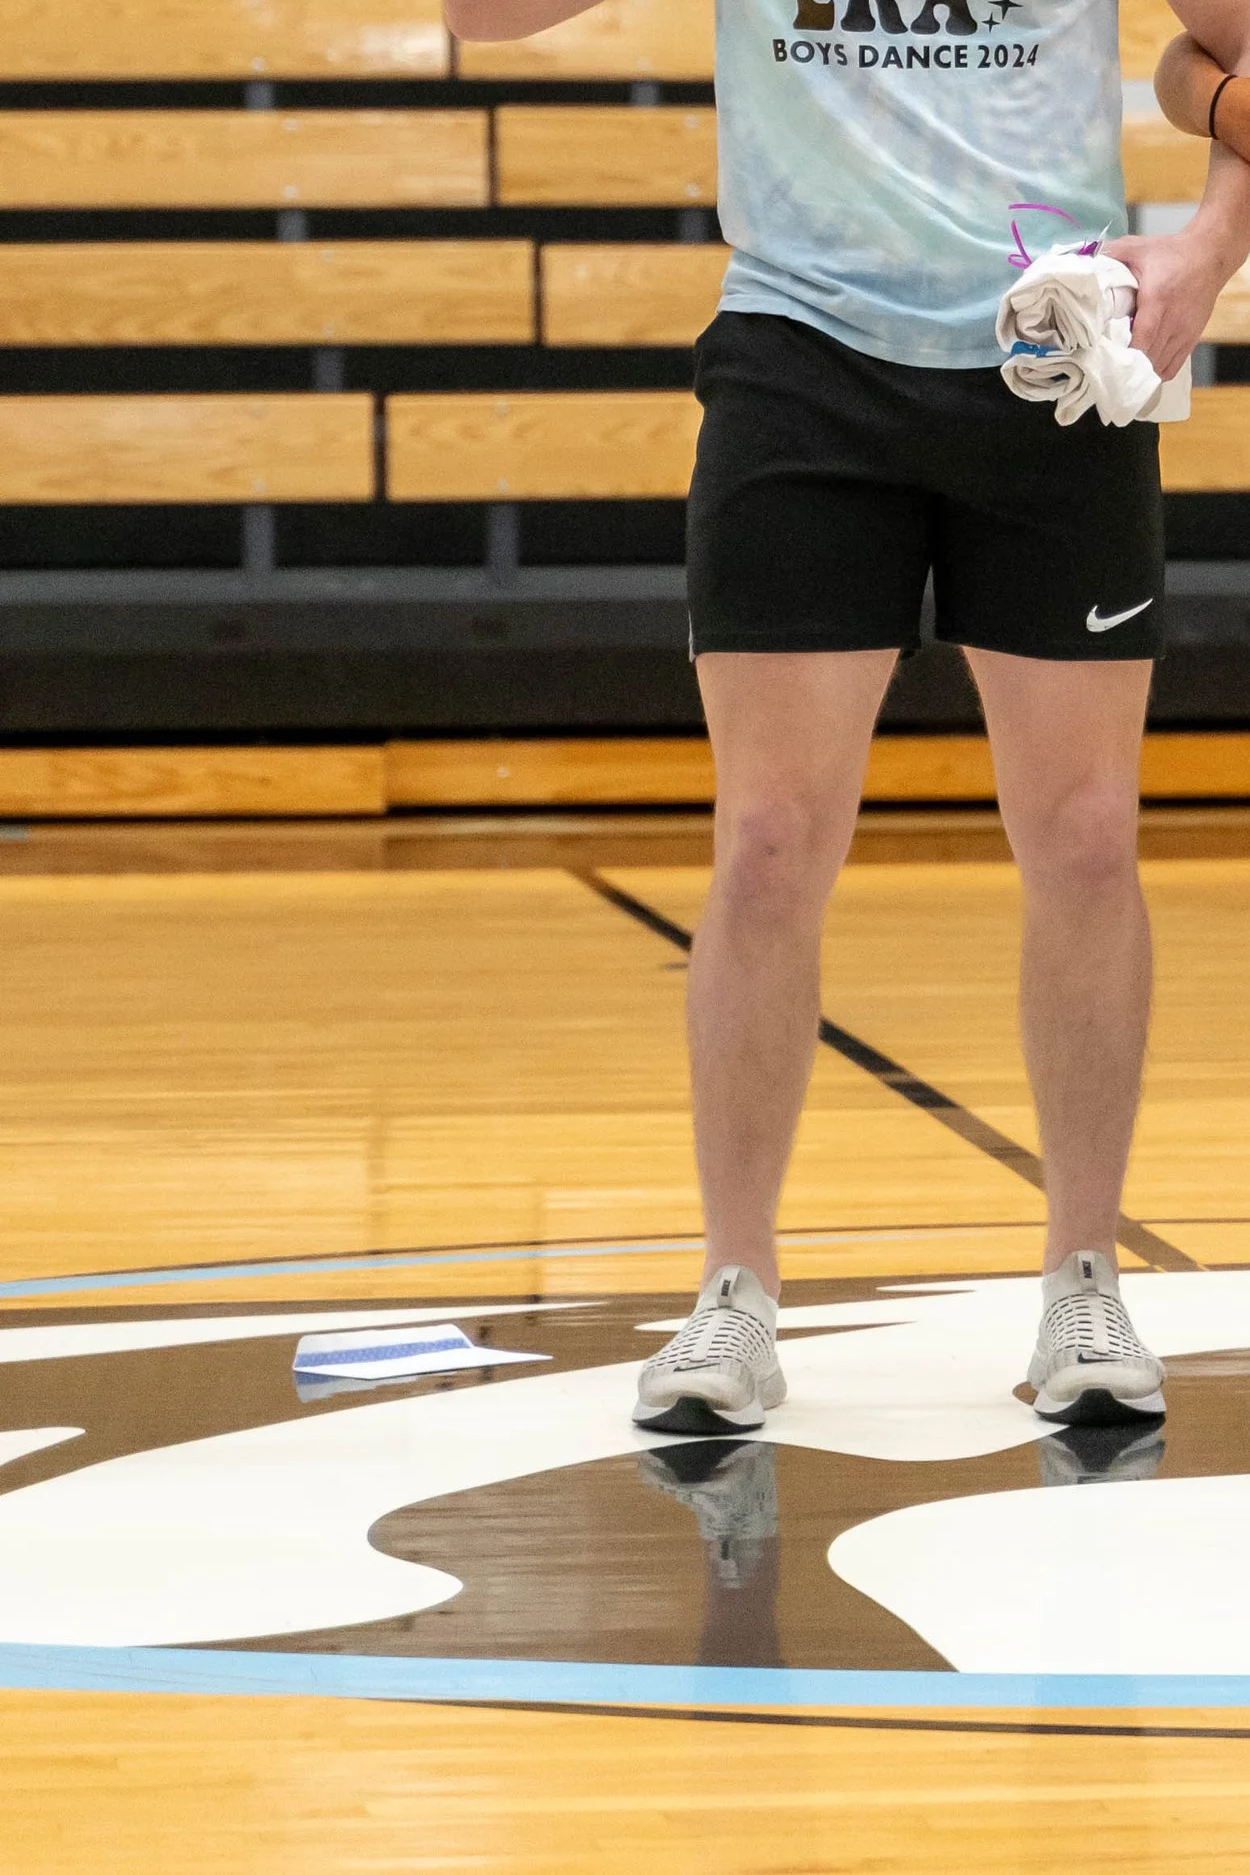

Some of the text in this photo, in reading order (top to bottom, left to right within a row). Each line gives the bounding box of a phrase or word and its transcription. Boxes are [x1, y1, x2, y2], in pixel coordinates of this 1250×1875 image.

[772, 38, 1040, 69] BOYS DANCE 2024
